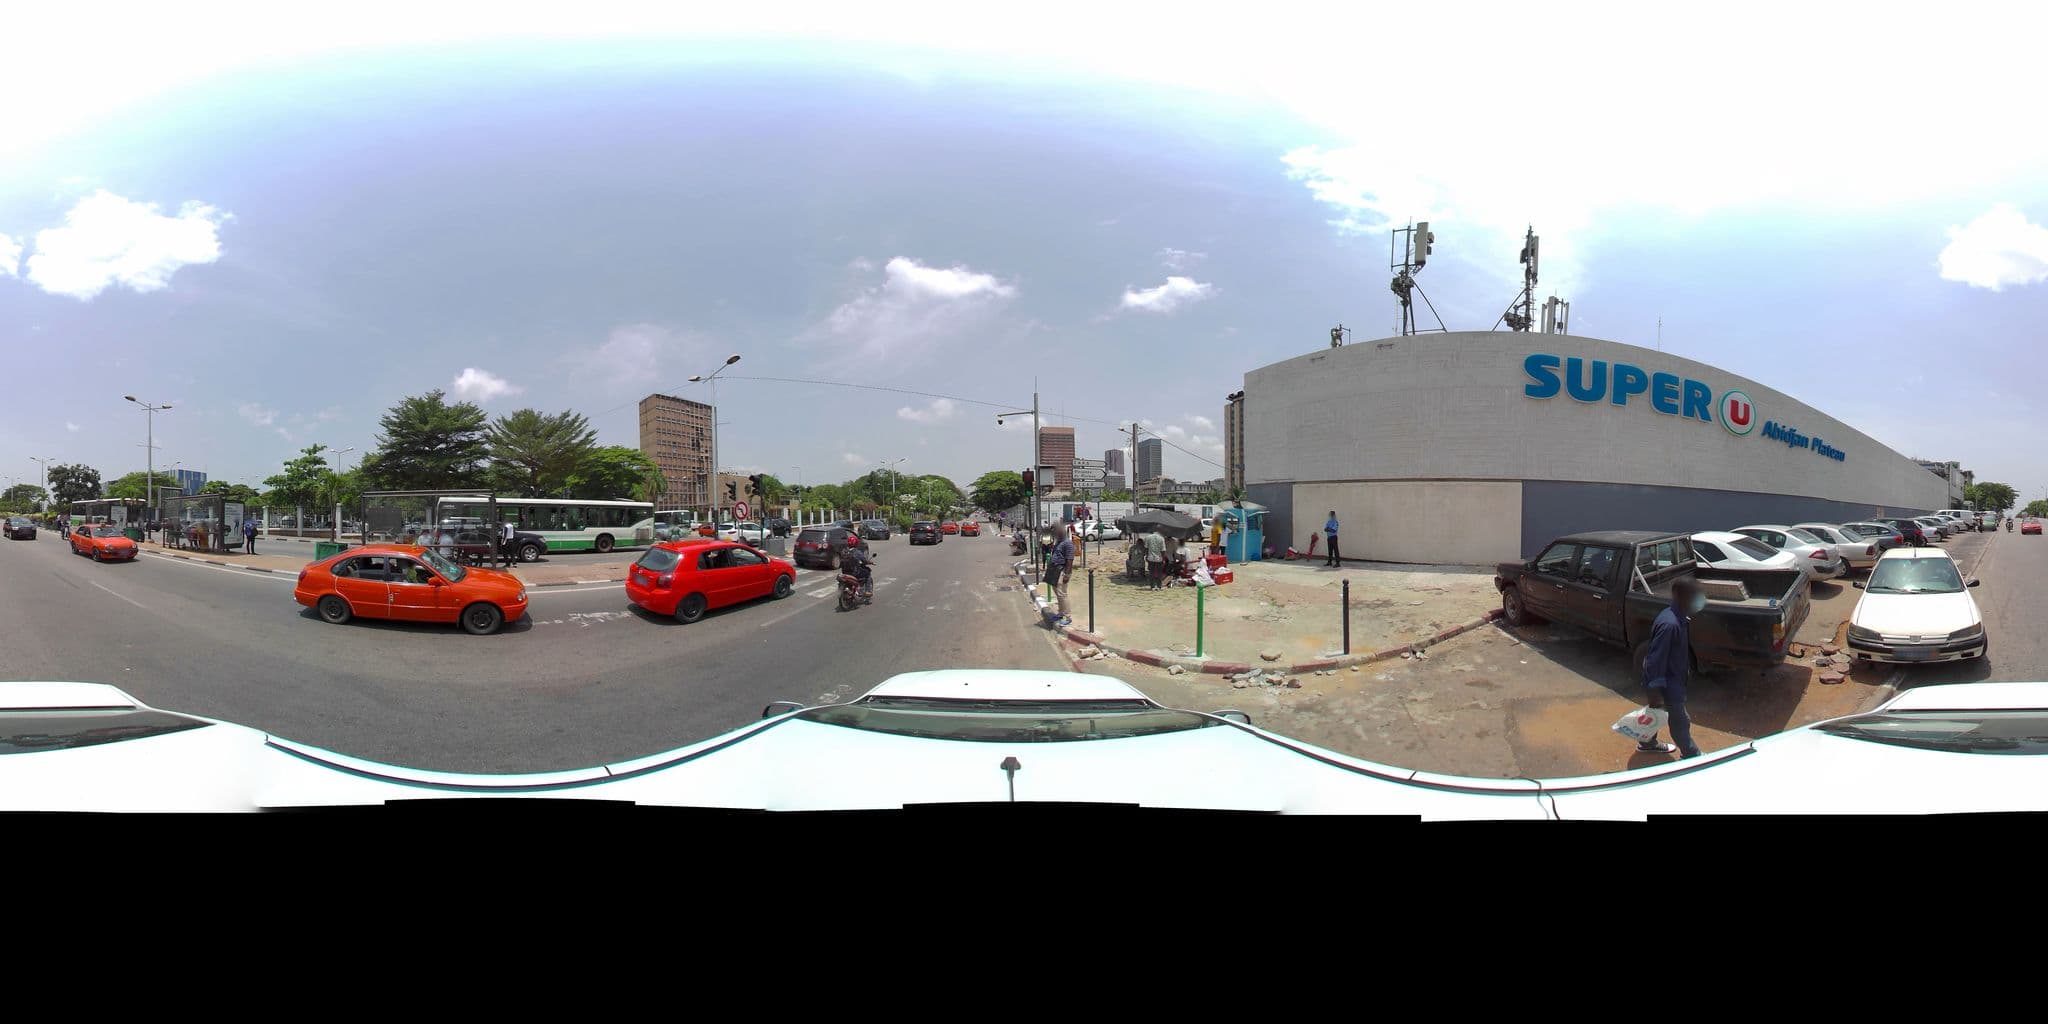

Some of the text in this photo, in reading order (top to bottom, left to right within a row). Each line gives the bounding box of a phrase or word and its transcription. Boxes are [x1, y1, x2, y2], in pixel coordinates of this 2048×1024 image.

[1523, 354, 1750, 426] SUPER U
[1761, 420, 1845, 462] Abidjan Plateau
